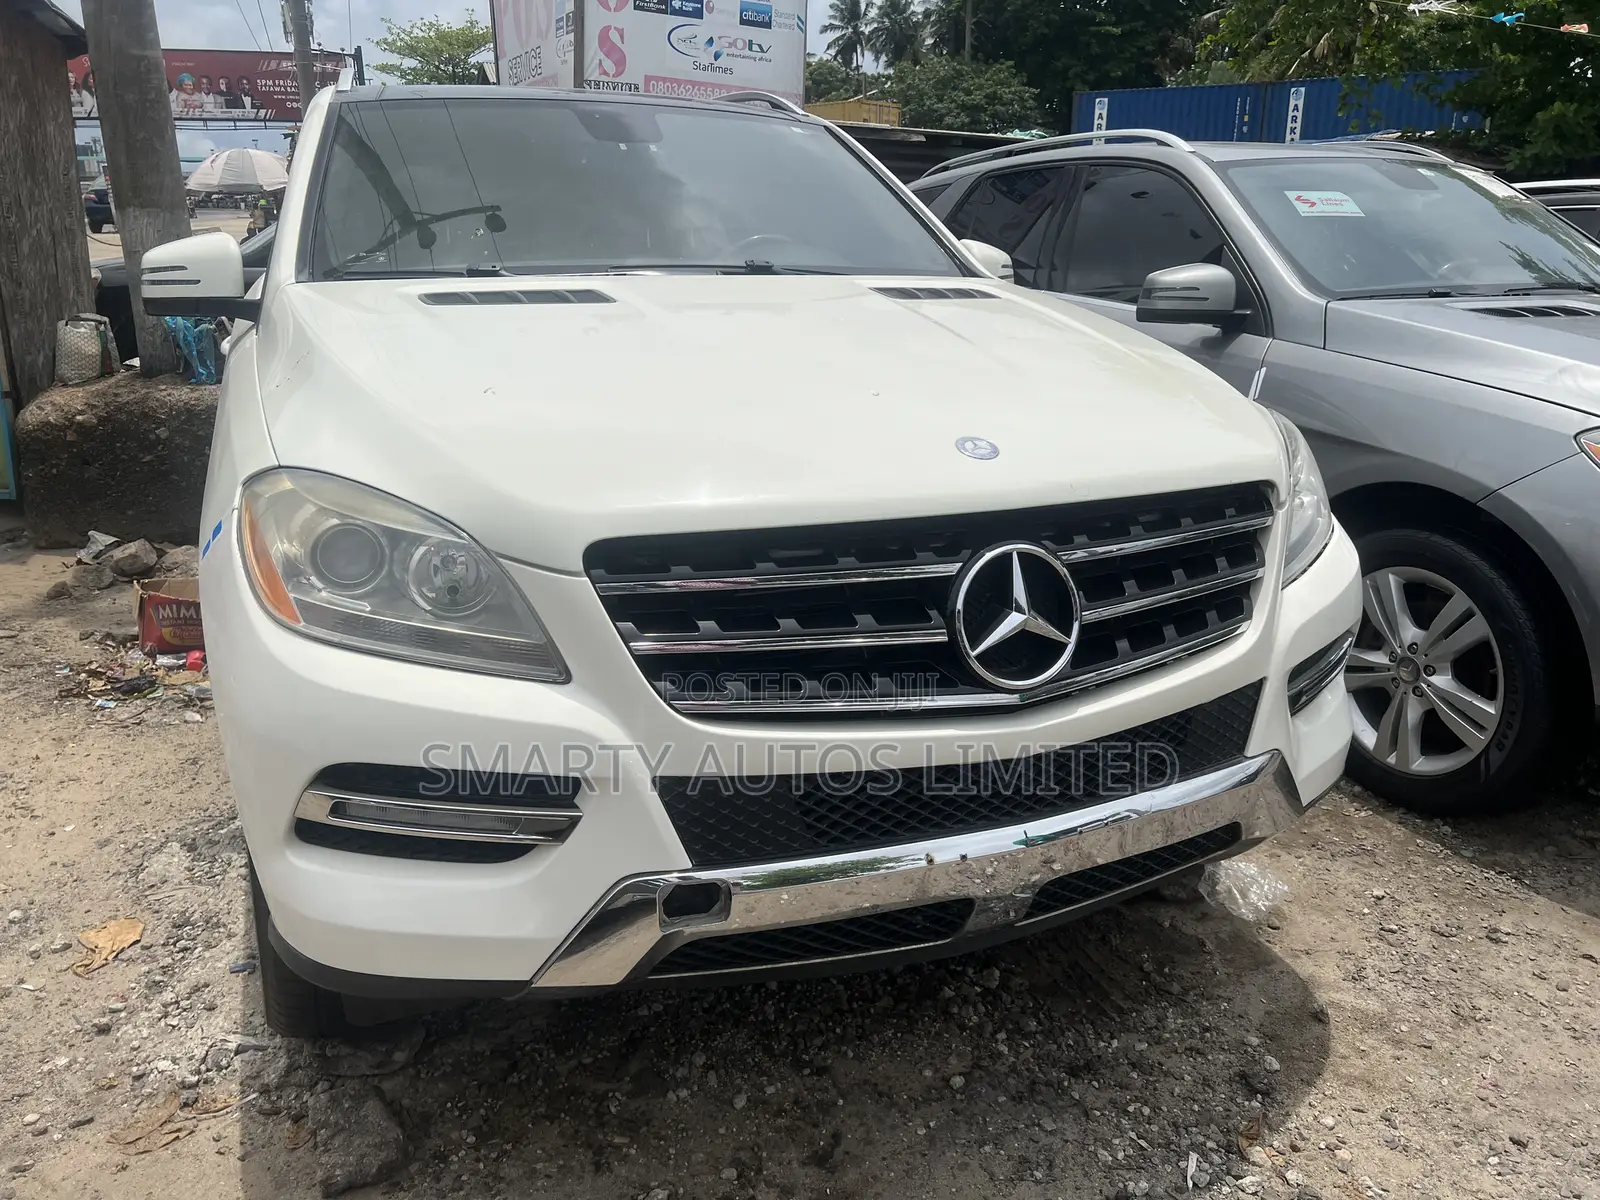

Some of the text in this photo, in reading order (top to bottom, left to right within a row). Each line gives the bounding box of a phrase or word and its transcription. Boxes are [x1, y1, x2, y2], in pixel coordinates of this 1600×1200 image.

[742, 8, 770, 22] citibank
[726, 52, 757, 62] entertaining
[507, 45, 543, 86] SERVICE
[692, 61, 734, 75] StarTimes
[583, 79, 640, 93] SERVICE
[1289, 103, 1301, 144] ARKA
